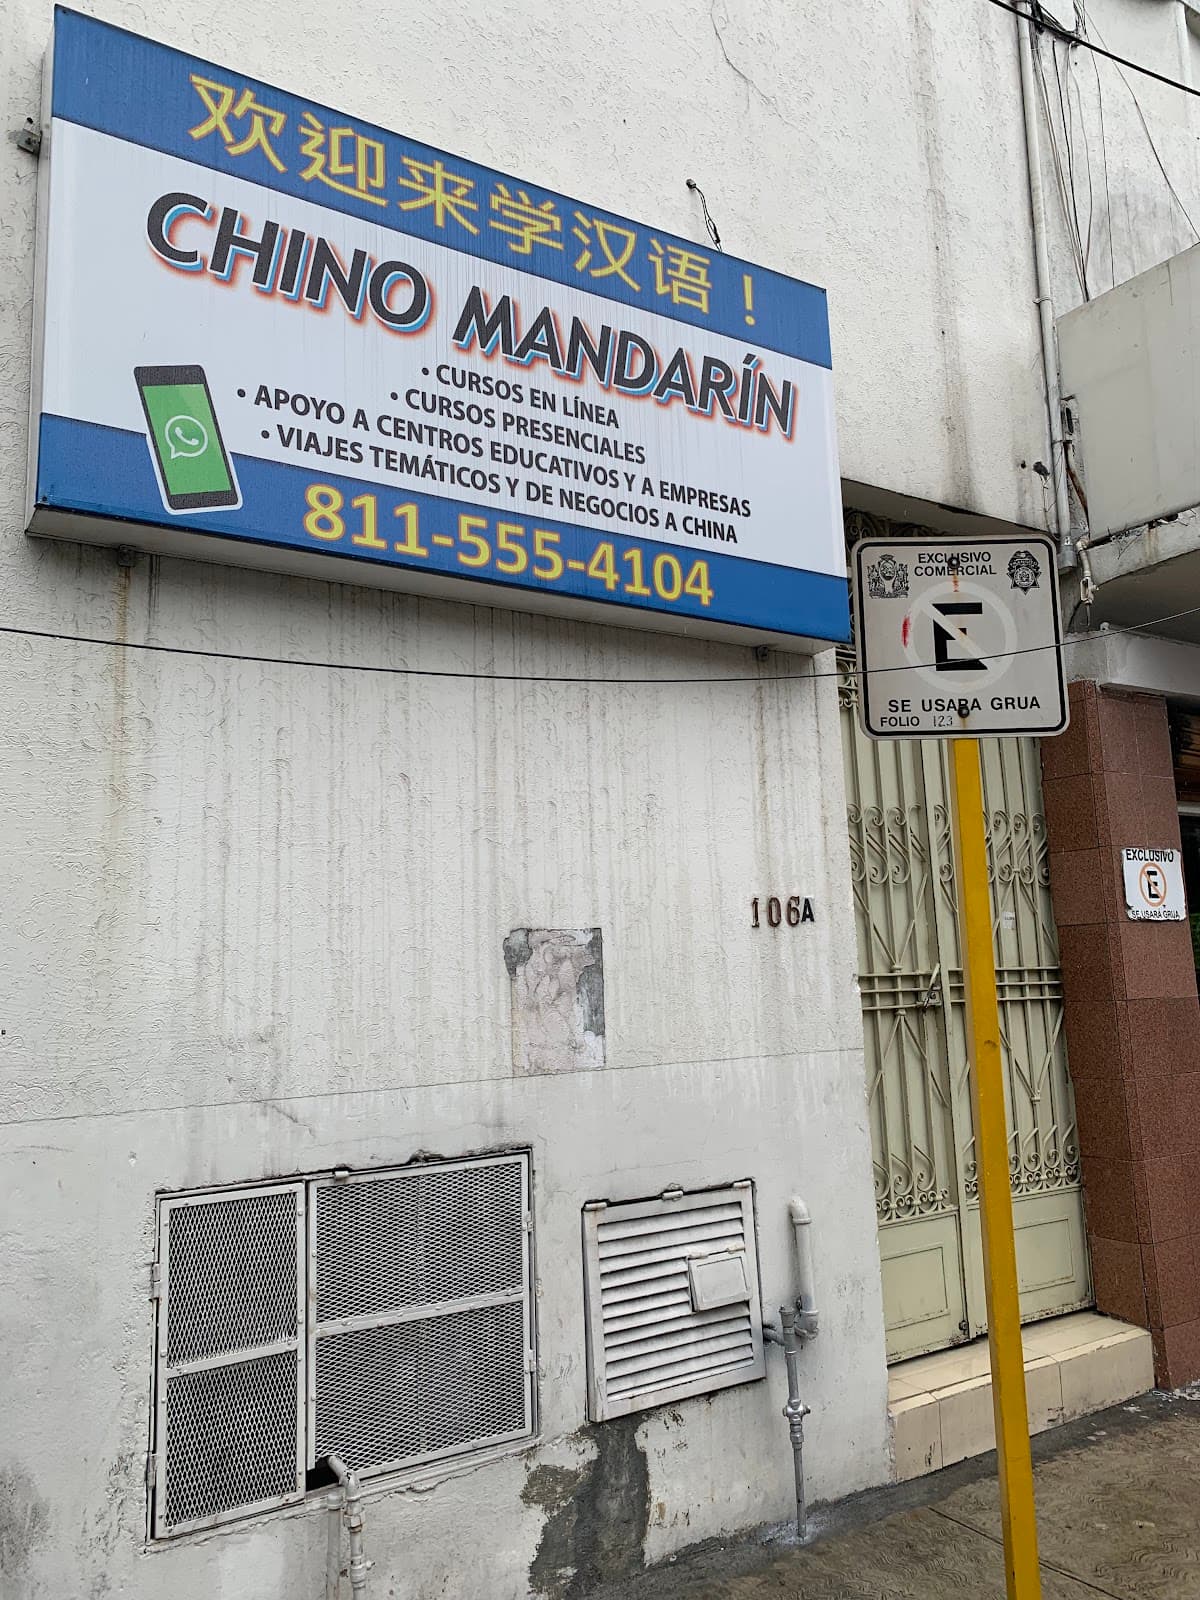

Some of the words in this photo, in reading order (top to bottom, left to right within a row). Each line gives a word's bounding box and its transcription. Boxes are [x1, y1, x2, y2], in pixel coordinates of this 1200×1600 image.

[147, 191, 432, 332] CHINO
[452, 285, 797, 438] MANDARÍN
[405, 389, 496, 428] CURSOS
[502, 411, 645, 464] PRESENCIALES
[436, 365, 523, 404] CURSOS
[529, 388, 556, 412] EN
[562, 395, 620, 428] LÍNEA
[254, 384, 346, 424] APOYO
[352, 408, 370, 431] A
[376, 415, 484, 457] CENTROS
[490, 440, 619, 488] EDUCATIVOS
[624, 471, 637, 492] Y
[641, 477, 655, 496] A
[660, 480, 752, 517] EMPRESAS
[276, 424, 364, 463] VIAJES
[369, 445, 501, 493] TEMÁTICOS
[505, 476, 520, 497] Y
[526, 481, 553, 505] DE
[559, 488, 660, 527] NEGOCIOS
[665, 512, 678, 531] A
[682, 515, 738, 543] CHINA
[302, 483, 714, 606] 811-555-4104
[914, 564, 997, 577] COMERCIAL
[879, 716, 920, 727] FOLIO
[888, 699, 912, 713] SE
[921, 698, 982, 712] USARA
[990, 696, 1041, 710] GRUA
[1125, 848, 1174, 862] EXCLUSIVO
[1131, 910, 1140, 918] SE
